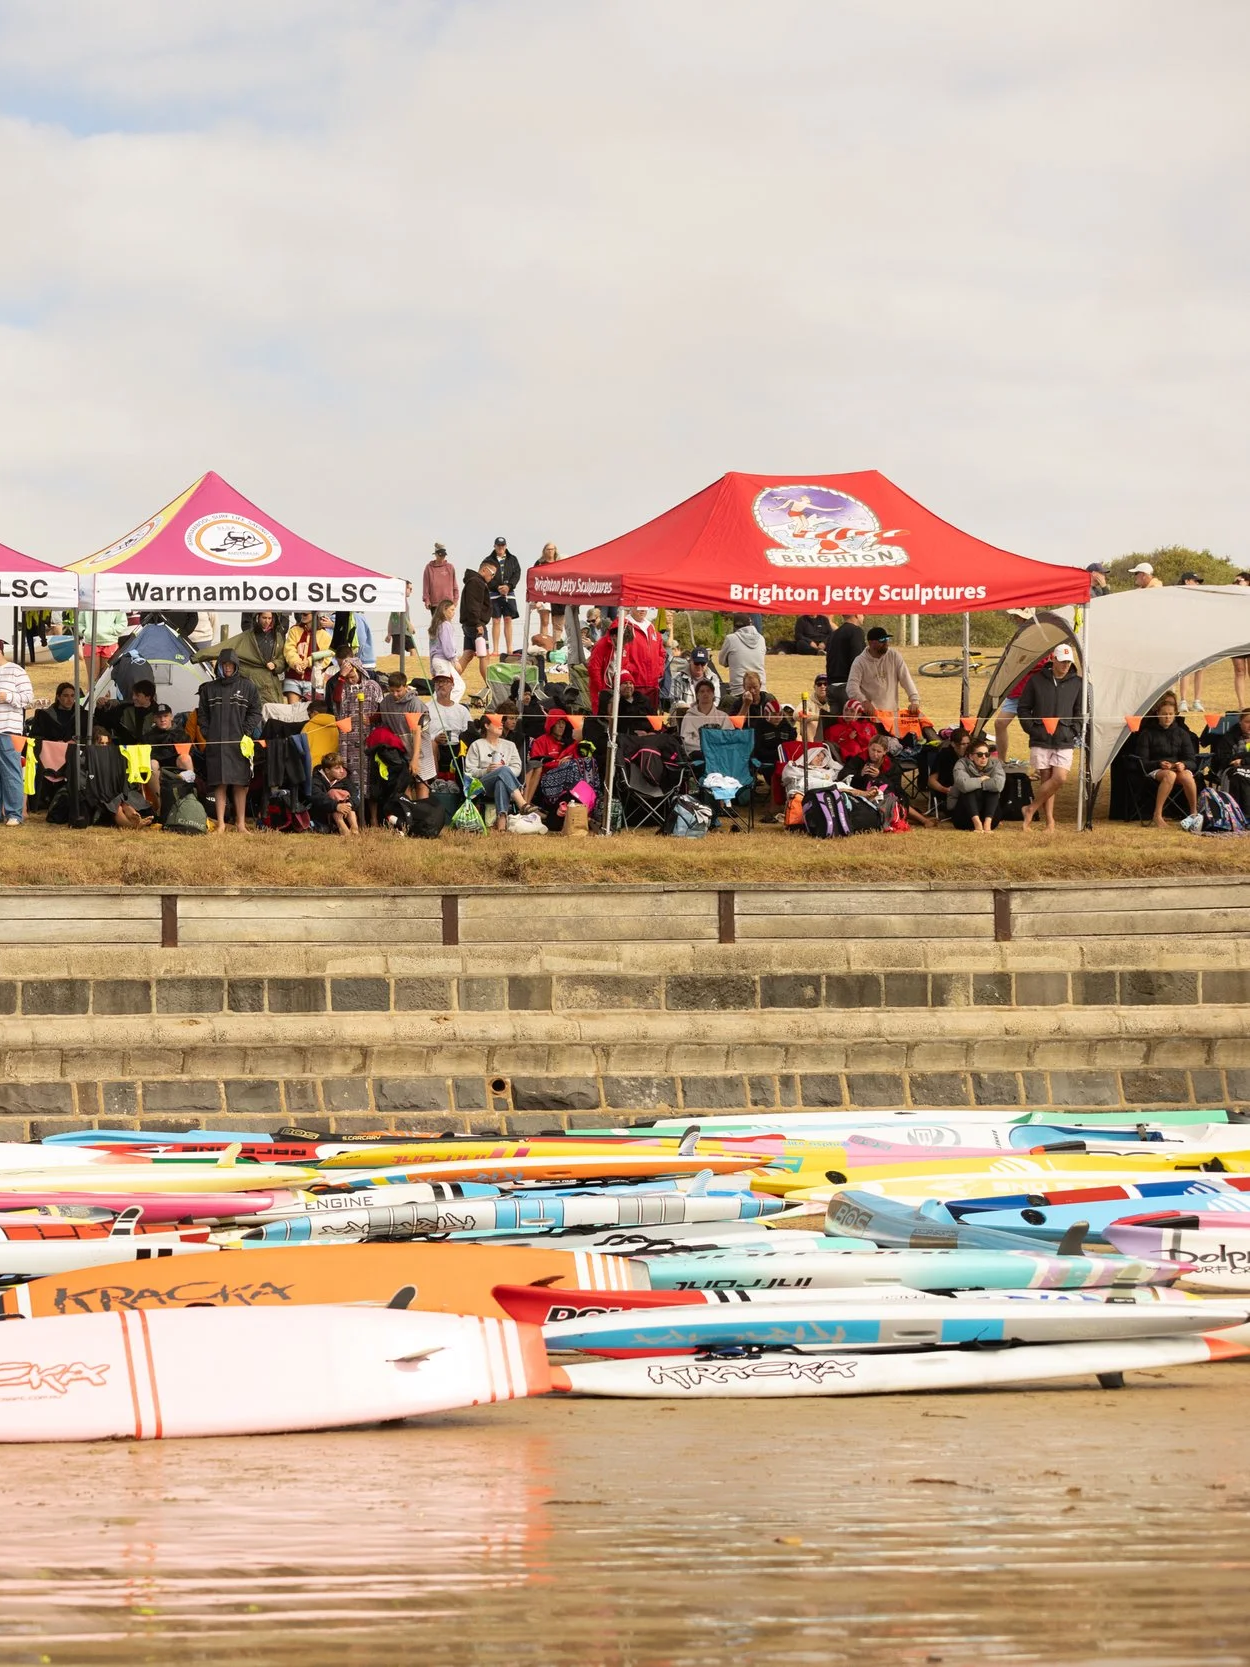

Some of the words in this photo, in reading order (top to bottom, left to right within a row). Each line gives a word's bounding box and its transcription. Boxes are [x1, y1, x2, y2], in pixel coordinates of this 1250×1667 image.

[782, 550, 894, 564] BRIGHTON
[126, 581, 297, 602] Warrnambool
[307, 582, 377, 603] SLSC
[534, 576, 561, 596] Brighton
[559, 577, 577, 596] Jetty
[576, 577, 613, 597] Sculptures
[730, 584, 819, 605] Brighton
[822, 585, 874, 606] Jetty
[879, 584, 986, 605] Sculptures
[305, 1195, 374, 1210] ENGINE
[835, 1204, 871, 1230] BOS
[1192, 1265, 1228, 1274] URF
[53, 1281, 296, 1314] KRACKA
[647, 1359, 858, 1390] KRACKA
